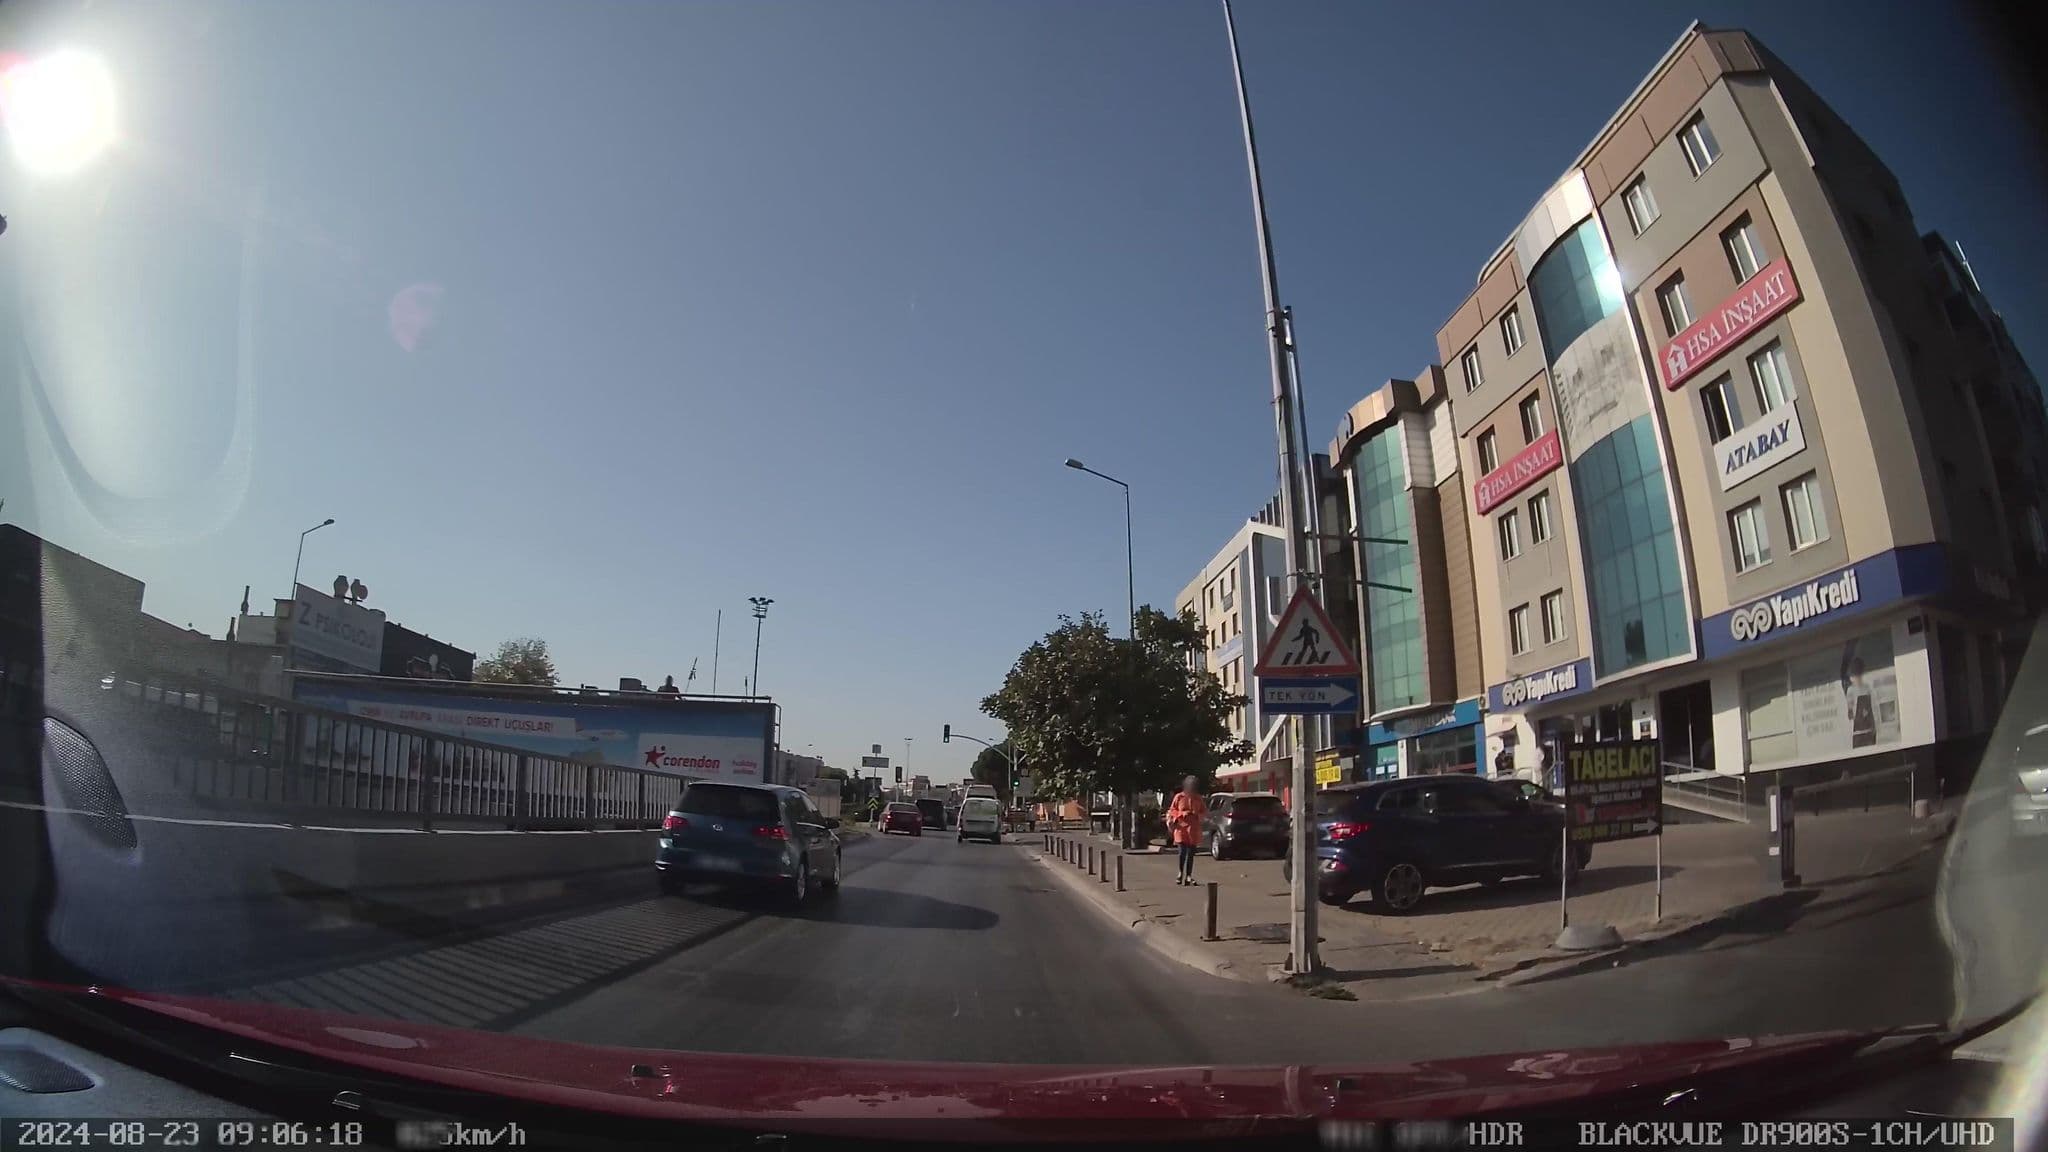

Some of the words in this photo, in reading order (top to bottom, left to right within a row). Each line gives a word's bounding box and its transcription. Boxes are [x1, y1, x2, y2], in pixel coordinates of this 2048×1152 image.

[1687, 322, 1721, 361] HSA
[1721, 270, 1786, 335] İNŞAAT
[1726, 419, 1790, 475] ATABAY
[1490, 471, 1513, 497] HSA
[1269, 691, 1292, 701] TEK
[663, 755, 721, 769] corendon
[1569, 746, 1656, 780] TABELACI
